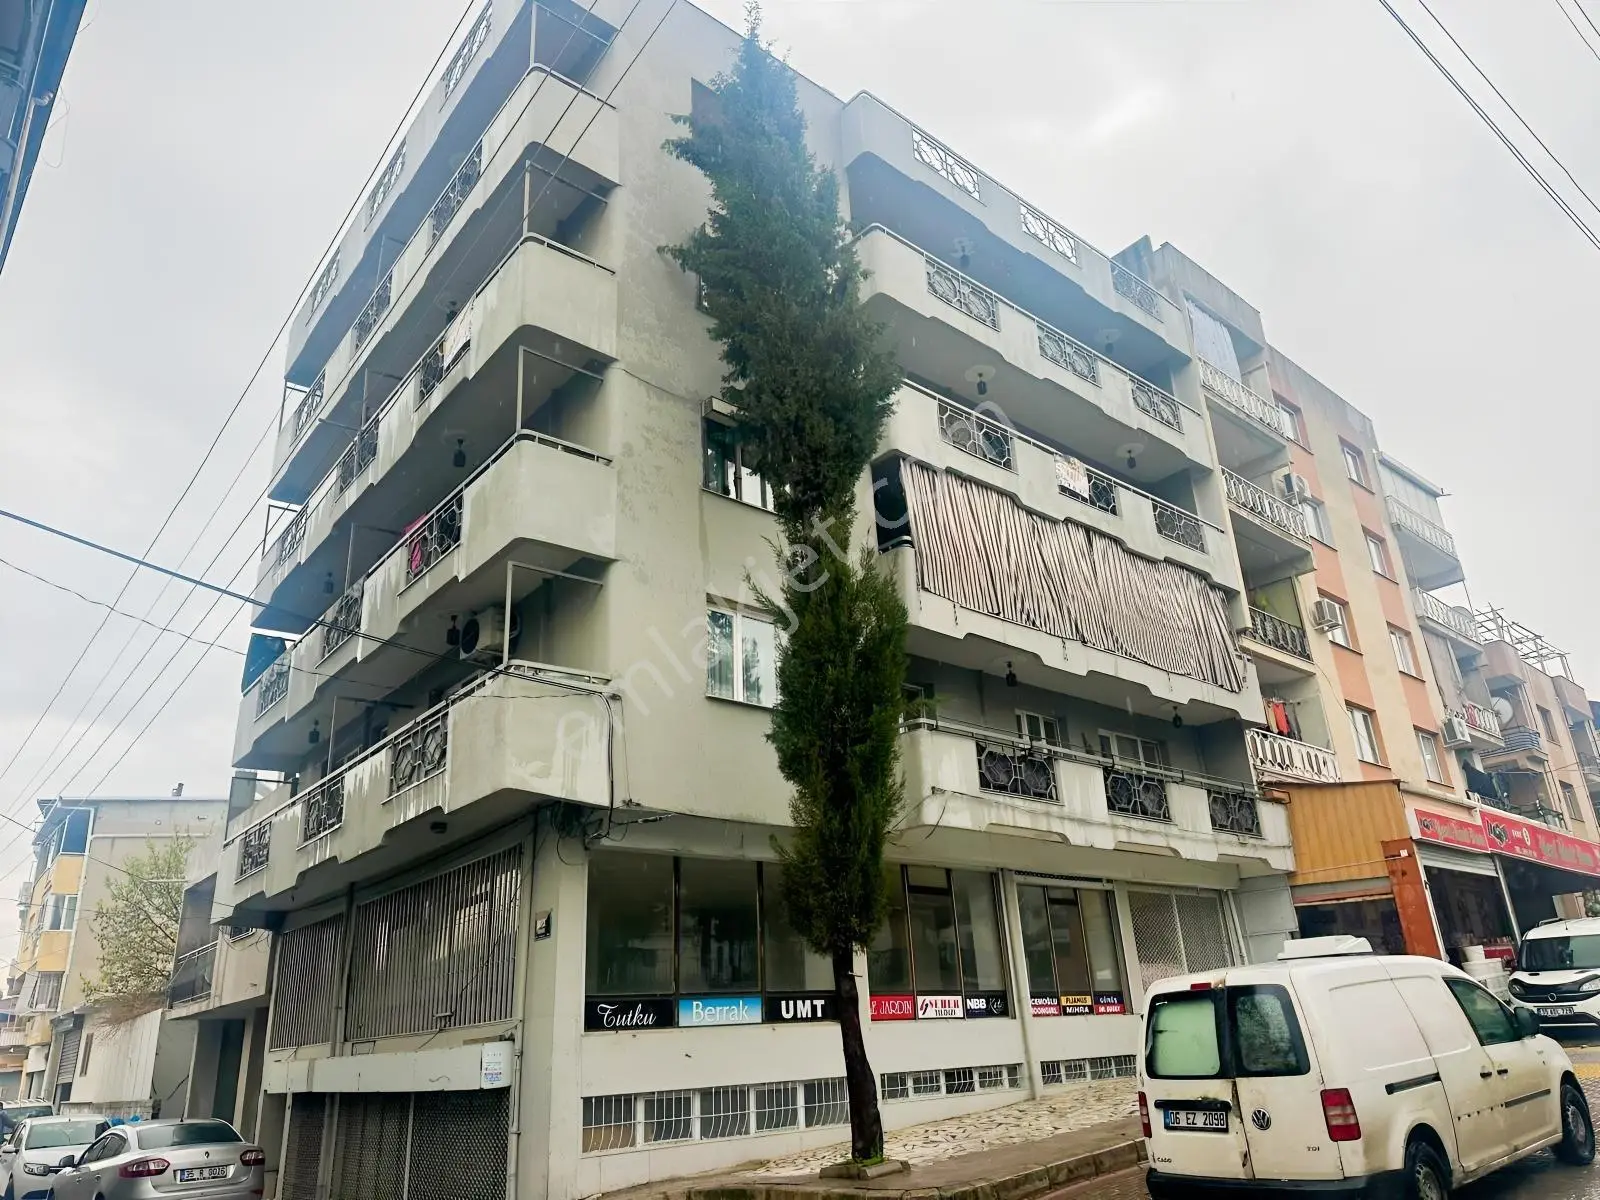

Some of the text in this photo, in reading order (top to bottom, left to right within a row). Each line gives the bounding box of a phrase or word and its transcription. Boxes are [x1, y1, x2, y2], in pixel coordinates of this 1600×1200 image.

[692, 1001, 750, 1023] Berrak
[780, 1000, 825, 1019] UMT
[880, 1000, 912, 1015] JARDIN
[966, 998, 987, 1010] NBB
[597, 1003, 657, 1028] Tutku
[1169, 1111, 1226, 1127] 06 EZ 2098
